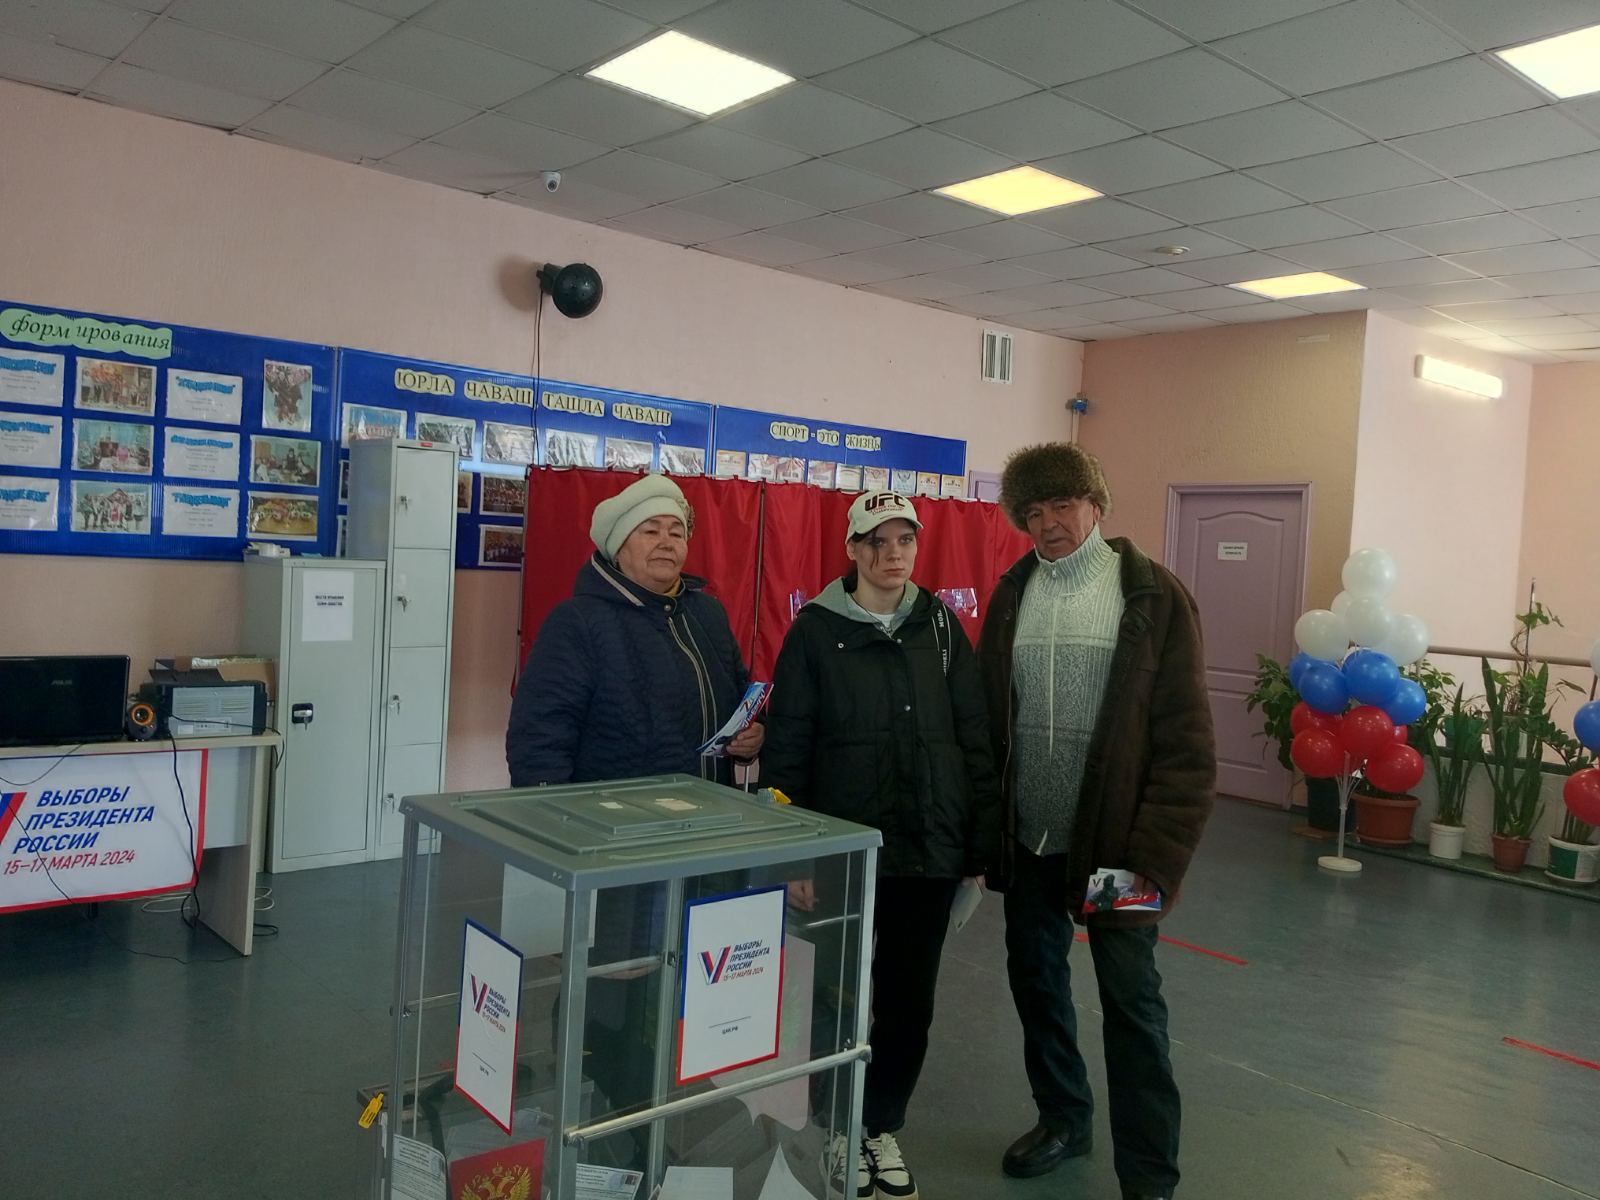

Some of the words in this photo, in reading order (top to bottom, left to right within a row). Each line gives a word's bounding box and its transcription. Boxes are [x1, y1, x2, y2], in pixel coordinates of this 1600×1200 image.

[466, 381, 532, 405] ЧАВАШ
[544, 393, 603, 416] ТАШЛА
[613, 404, 671, 425] ЧАВАШ
[771, 424, 807, 440] СПОРТ
[818, 431, 839, 444] ЭТО
[846, 436, 880, 450] ЖИЗНЬ
[865, 493, 906, 511] UFC
[36, 786, 130, 807] ВЫБОРЫ
[25, 806, 155, 831] ПРЕЗИДЕНТА
[12, 832, 99, 854] РОССИИ
[48, 853, 98, 870] МАРТА
[99, 849, 136, 866] 2024
[730, 947, 770, 963] ПРЕЗИДЕНТА
[733, 939, 763, 952] ВЫБОРЫ
[725, 961, 753, 973] РОССИИ
